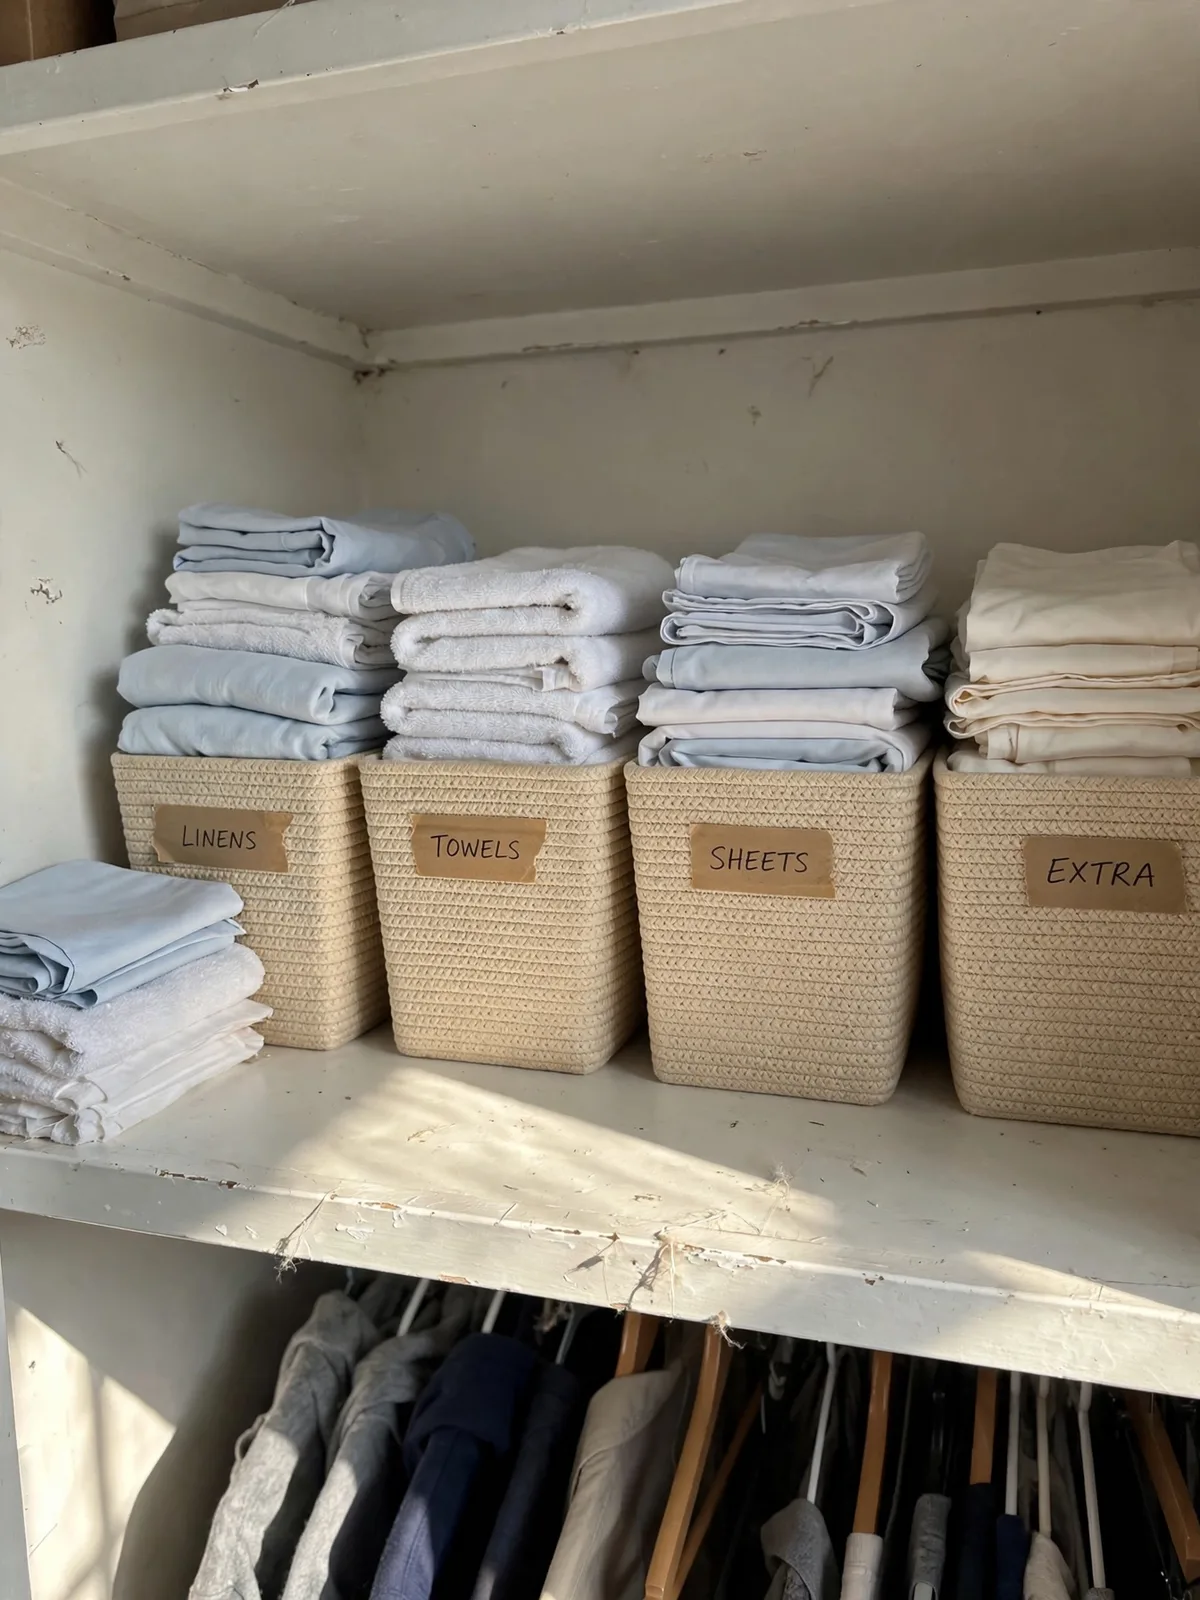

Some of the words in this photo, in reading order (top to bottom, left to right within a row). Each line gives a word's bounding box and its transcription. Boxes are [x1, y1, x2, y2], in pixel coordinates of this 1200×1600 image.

[182, 825, 257, 850] LINENS
[430, 834, 520, 860] TOWELS
[710, 845, 809, 873] SHEETS
[1046, 857, 1156, 888] EXTRA
